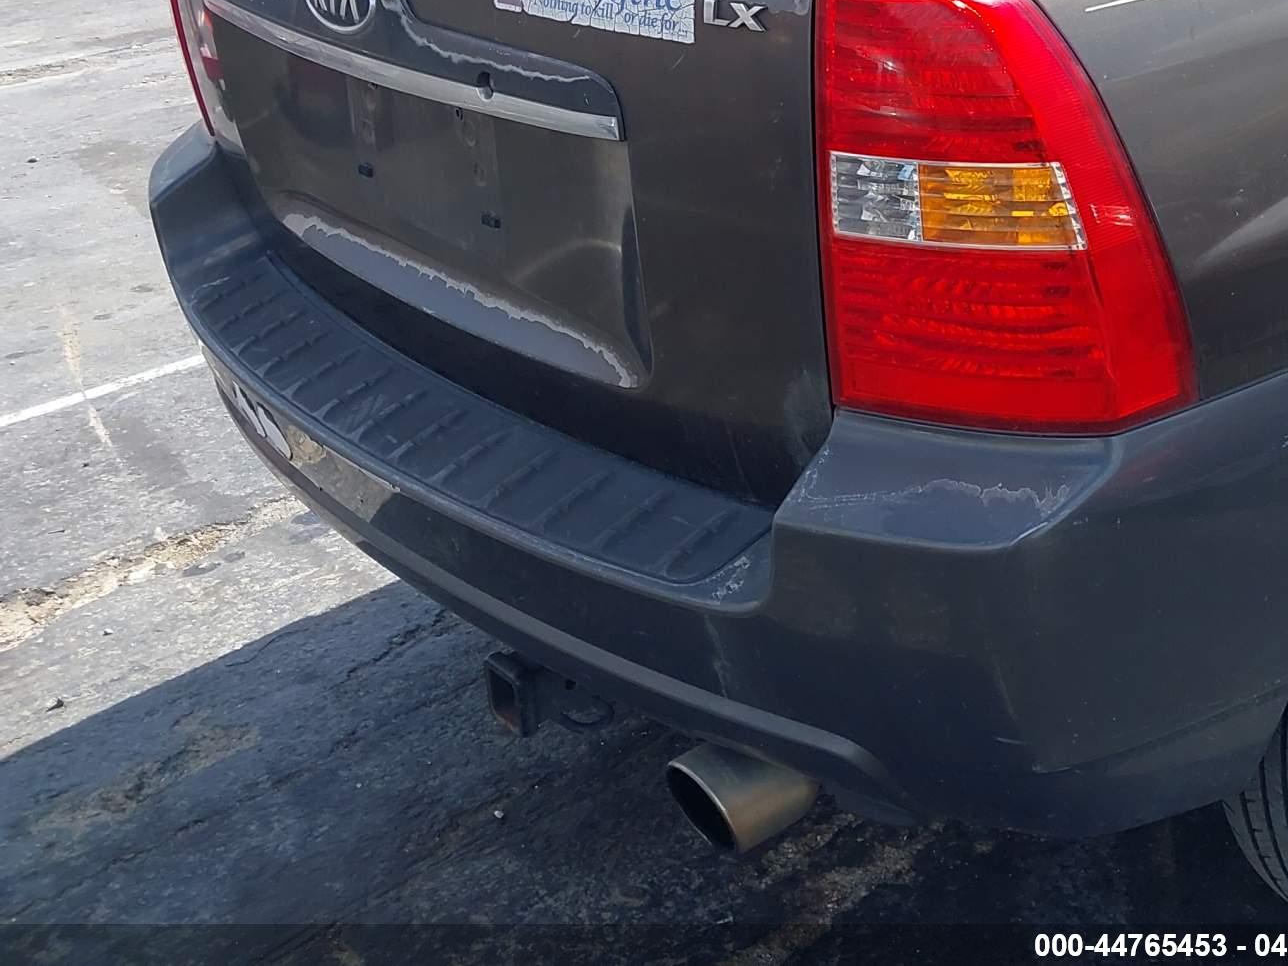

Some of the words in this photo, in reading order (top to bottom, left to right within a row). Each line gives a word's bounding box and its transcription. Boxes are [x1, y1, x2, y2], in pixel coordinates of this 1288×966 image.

[580, 1, 592, 16] to
[594, 0, 614, 20] kill
[623, 12, 638, 26] or
[639, 10, 658, 28] die
